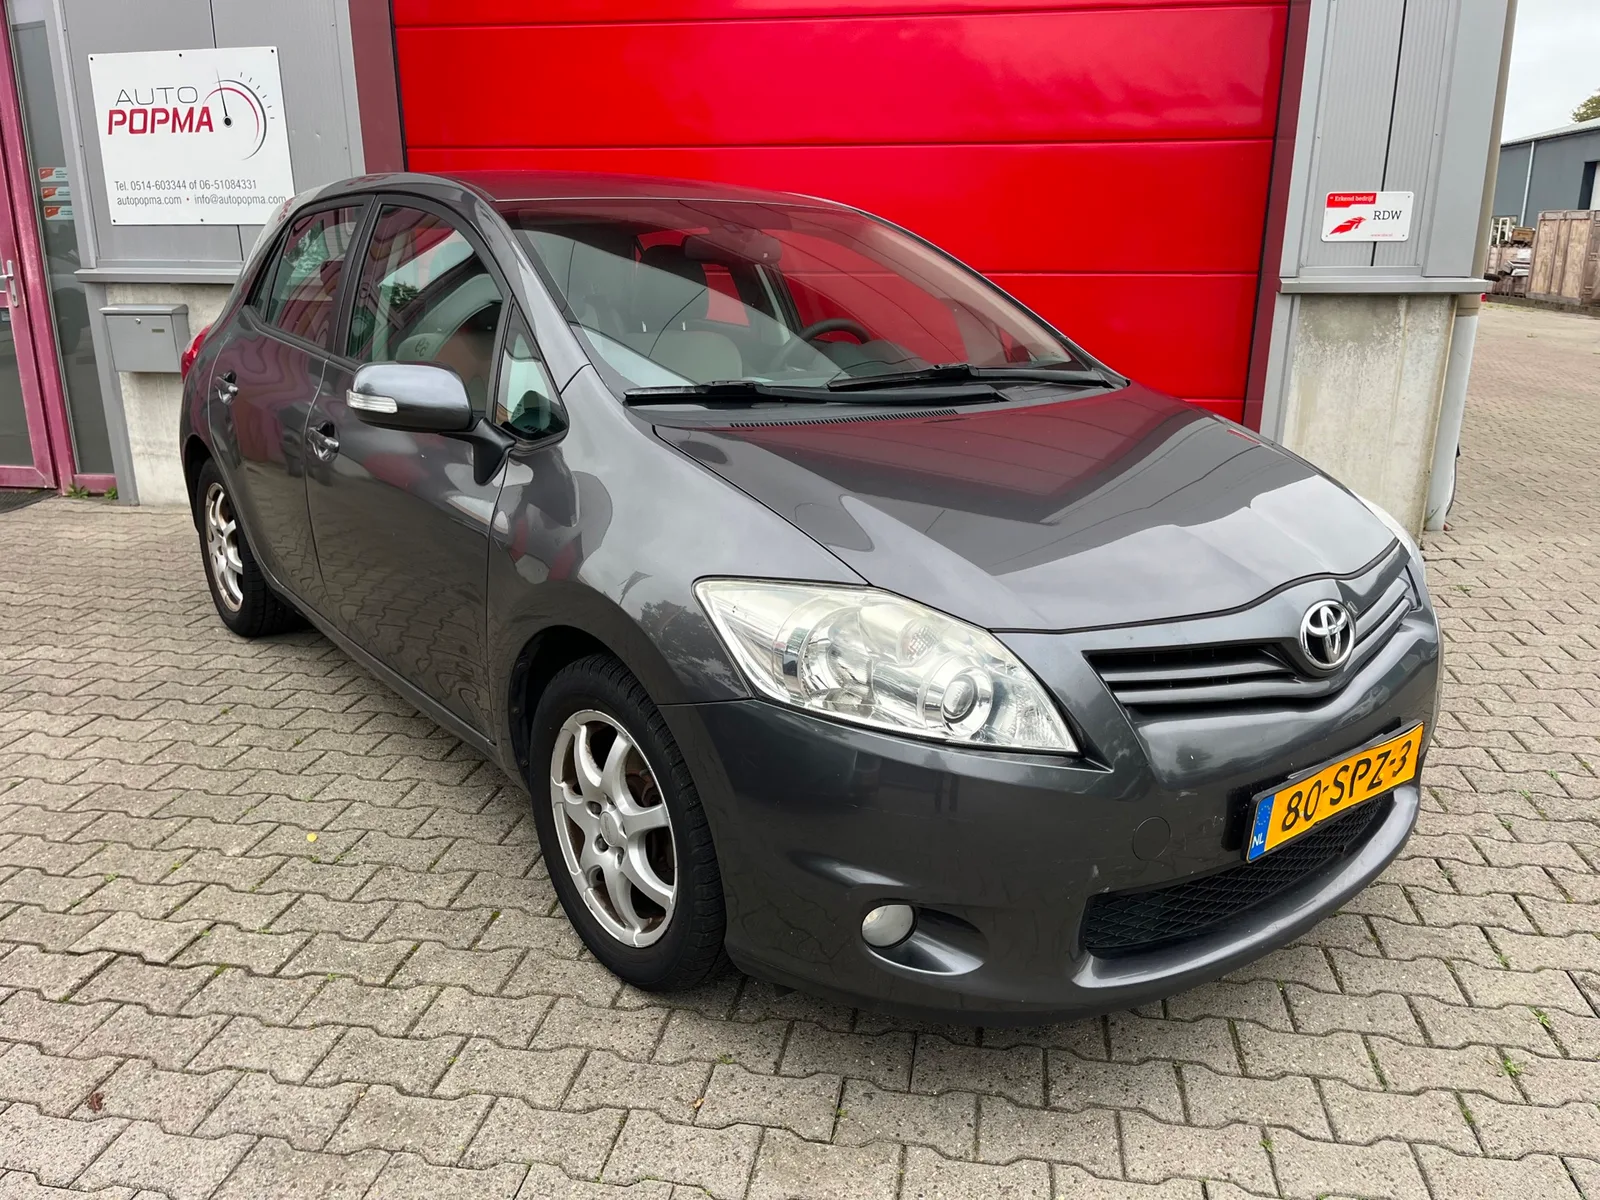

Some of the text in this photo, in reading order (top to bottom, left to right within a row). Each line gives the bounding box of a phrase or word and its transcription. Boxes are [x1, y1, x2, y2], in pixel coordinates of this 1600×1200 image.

[115, 86, 199, 107] AUTO
[107, 106, 214, 135] POPMA
[114, 179, 257, 191] Tel. 0514-603344 of 06-51084331
[116, 193, 287, 207] autopopma.com info@autopopma.com
[1373, 210, 1402, 220] RDW
[1281, 740, 1412, 832] 80-SPZ-3
[1251, 833, 1264, 849] NL
